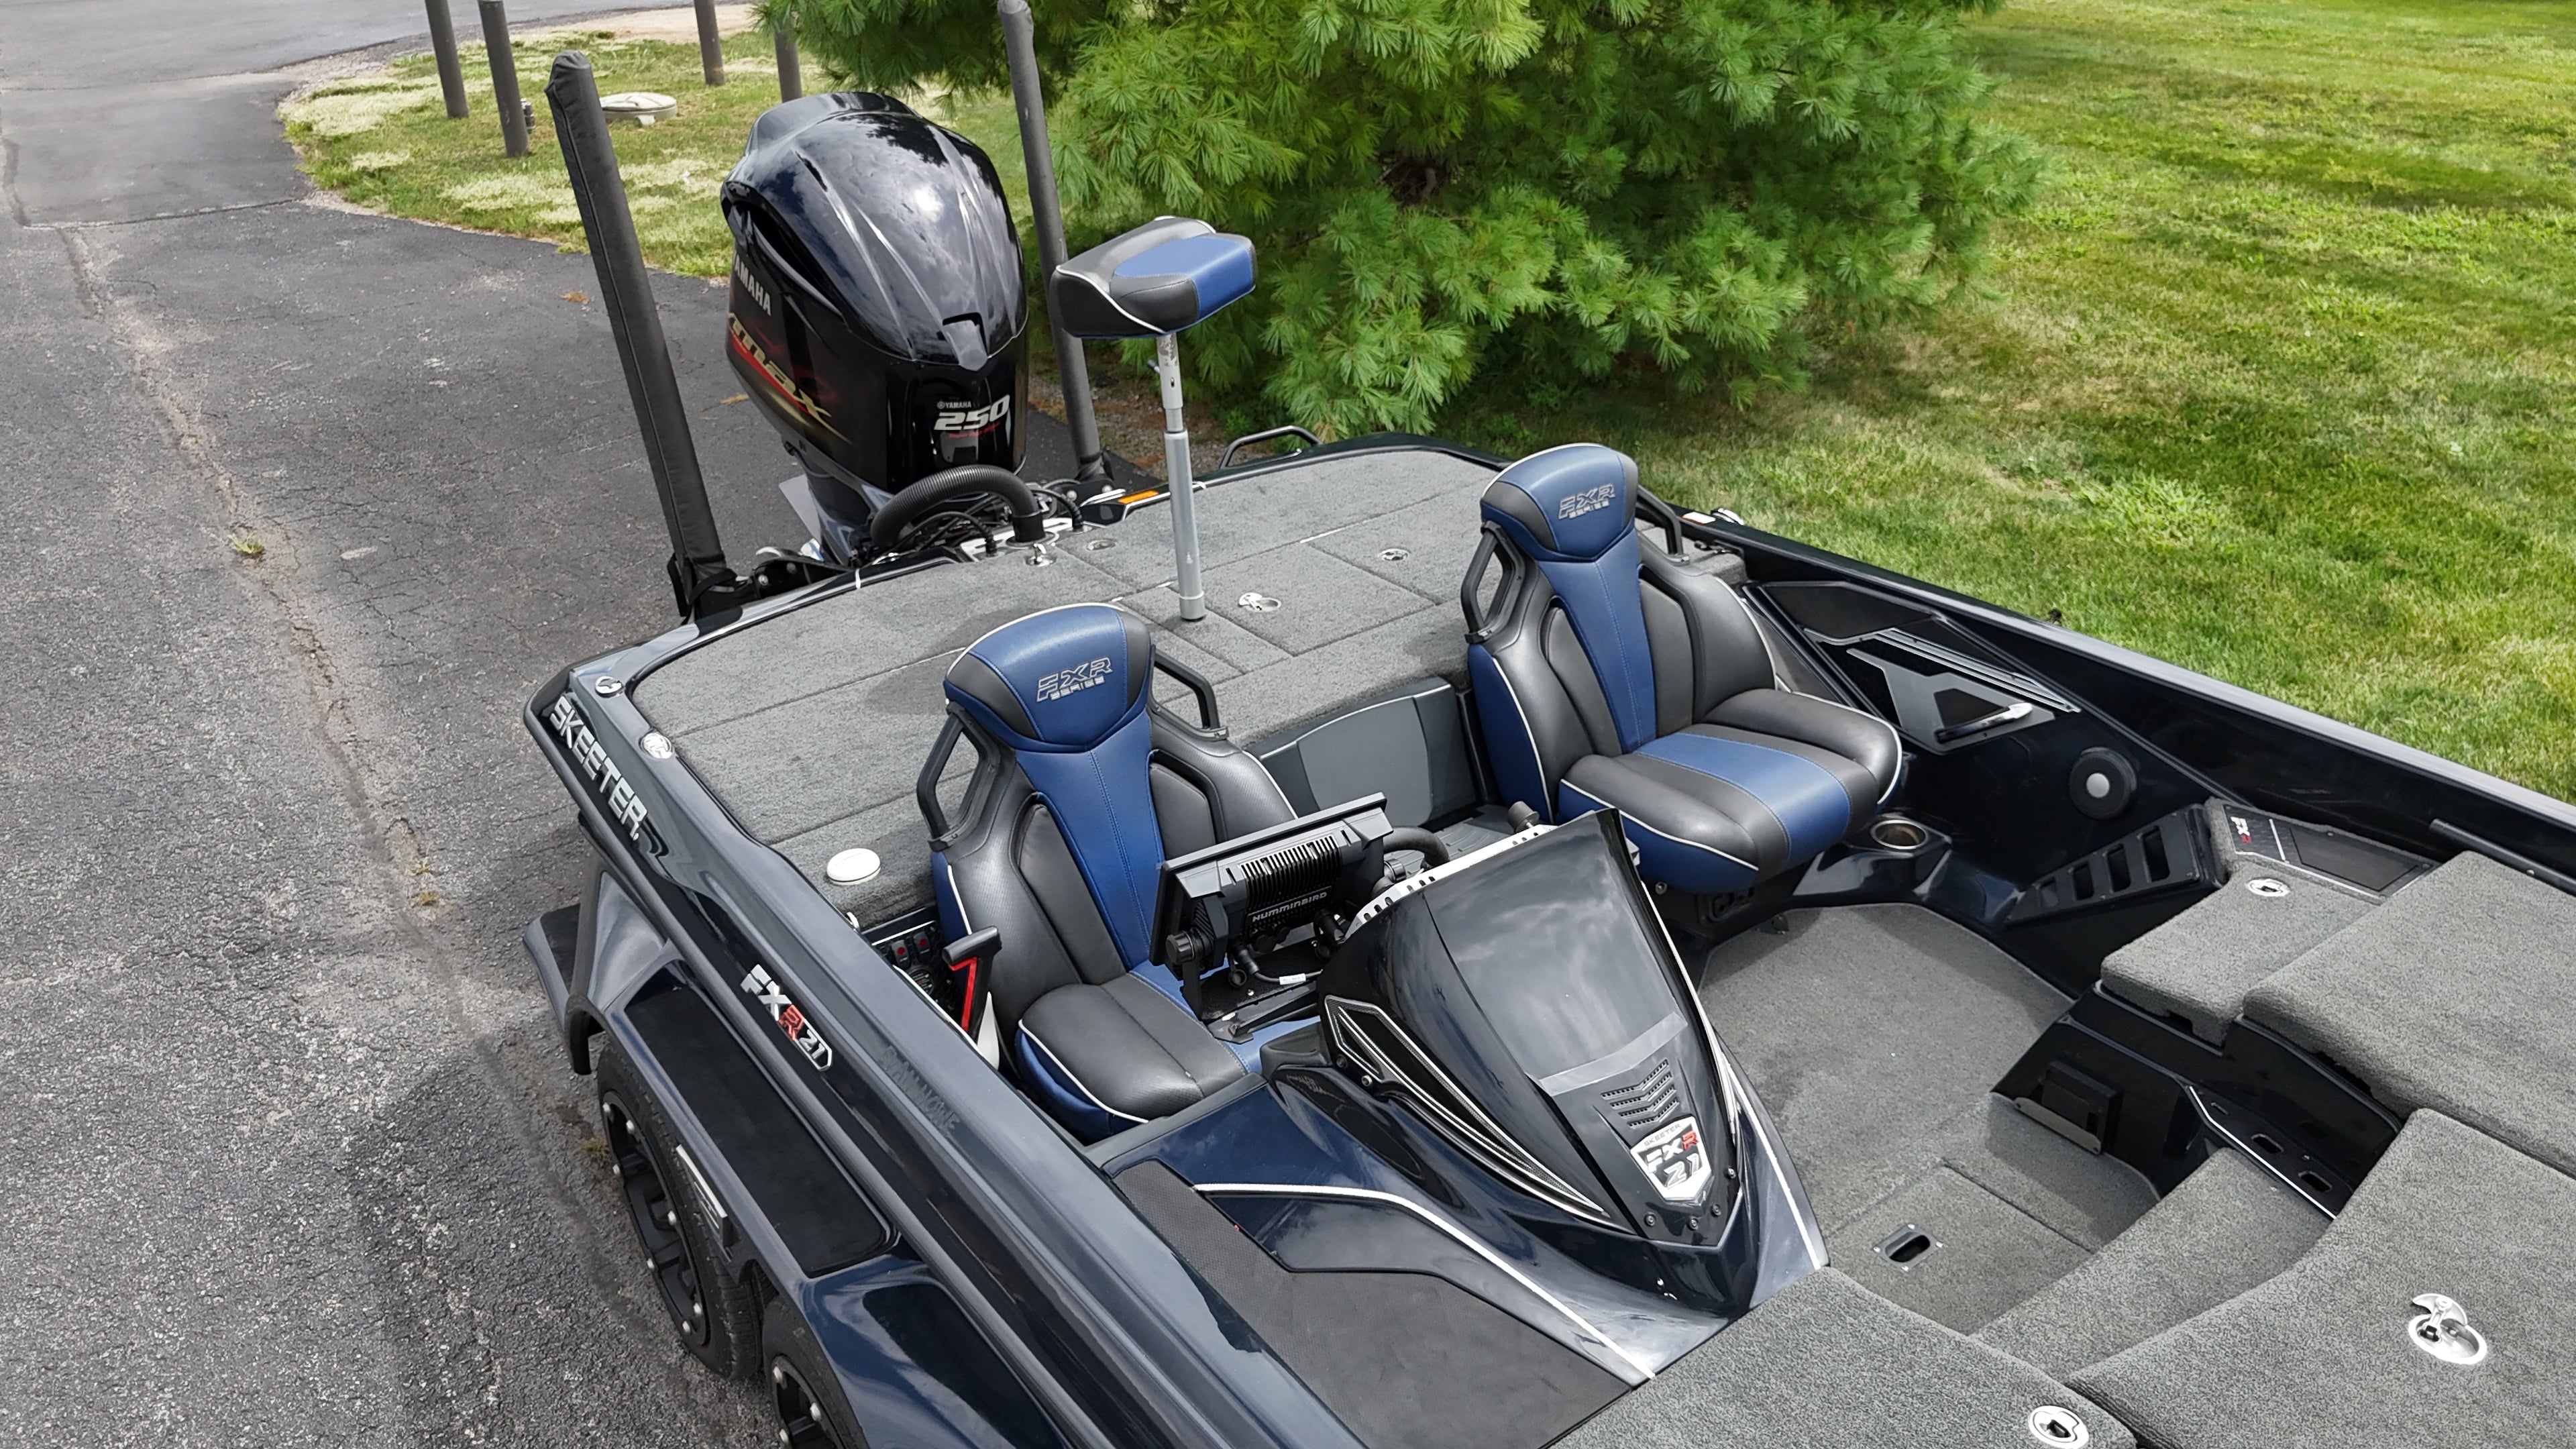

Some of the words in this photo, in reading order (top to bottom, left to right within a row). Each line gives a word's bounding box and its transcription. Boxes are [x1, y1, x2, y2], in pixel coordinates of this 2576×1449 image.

[934, 394, 1010, 431] 250
[1558, 483, 1616, 519] FXR
[1036, 657, 1114, 702] FXR
[549, 696, 647, 840] SKEETER
[1644, 1124, 1681, 1147] SKEETER
[1646, 1130, 1699, 1174] FXR
[1664, 1152, 1700, 1188] 21
